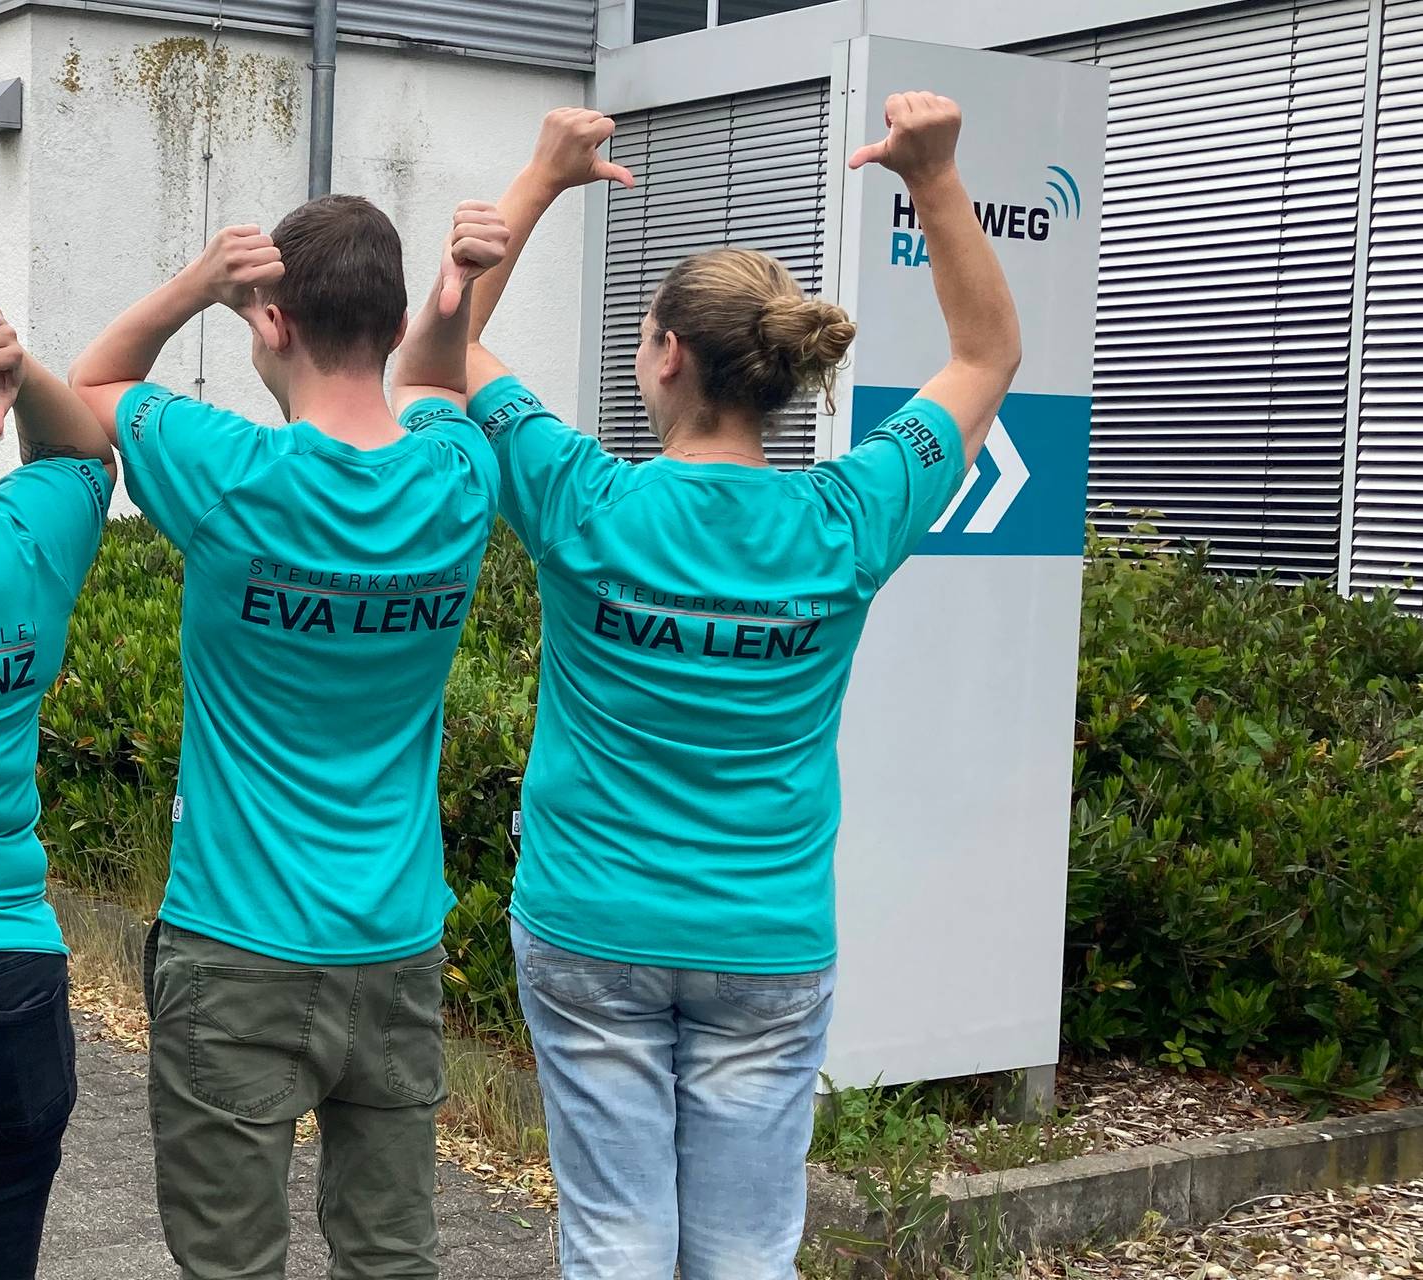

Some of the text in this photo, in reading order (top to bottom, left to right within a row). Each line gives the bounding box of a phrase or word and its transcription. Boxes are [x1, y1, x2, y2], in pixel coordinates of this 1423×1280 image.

[892, 193, 1050, 241] HWEG
[903, 417, 946, 463] RADIO
[248, 558, 470, 591] STEUERKANZLEI
[240, 585, 467, 634] EVA LENZ
[596, 580, 832, 617] STEUERKANZLEI
[594, 600, 821, 660] EVA LENZ
